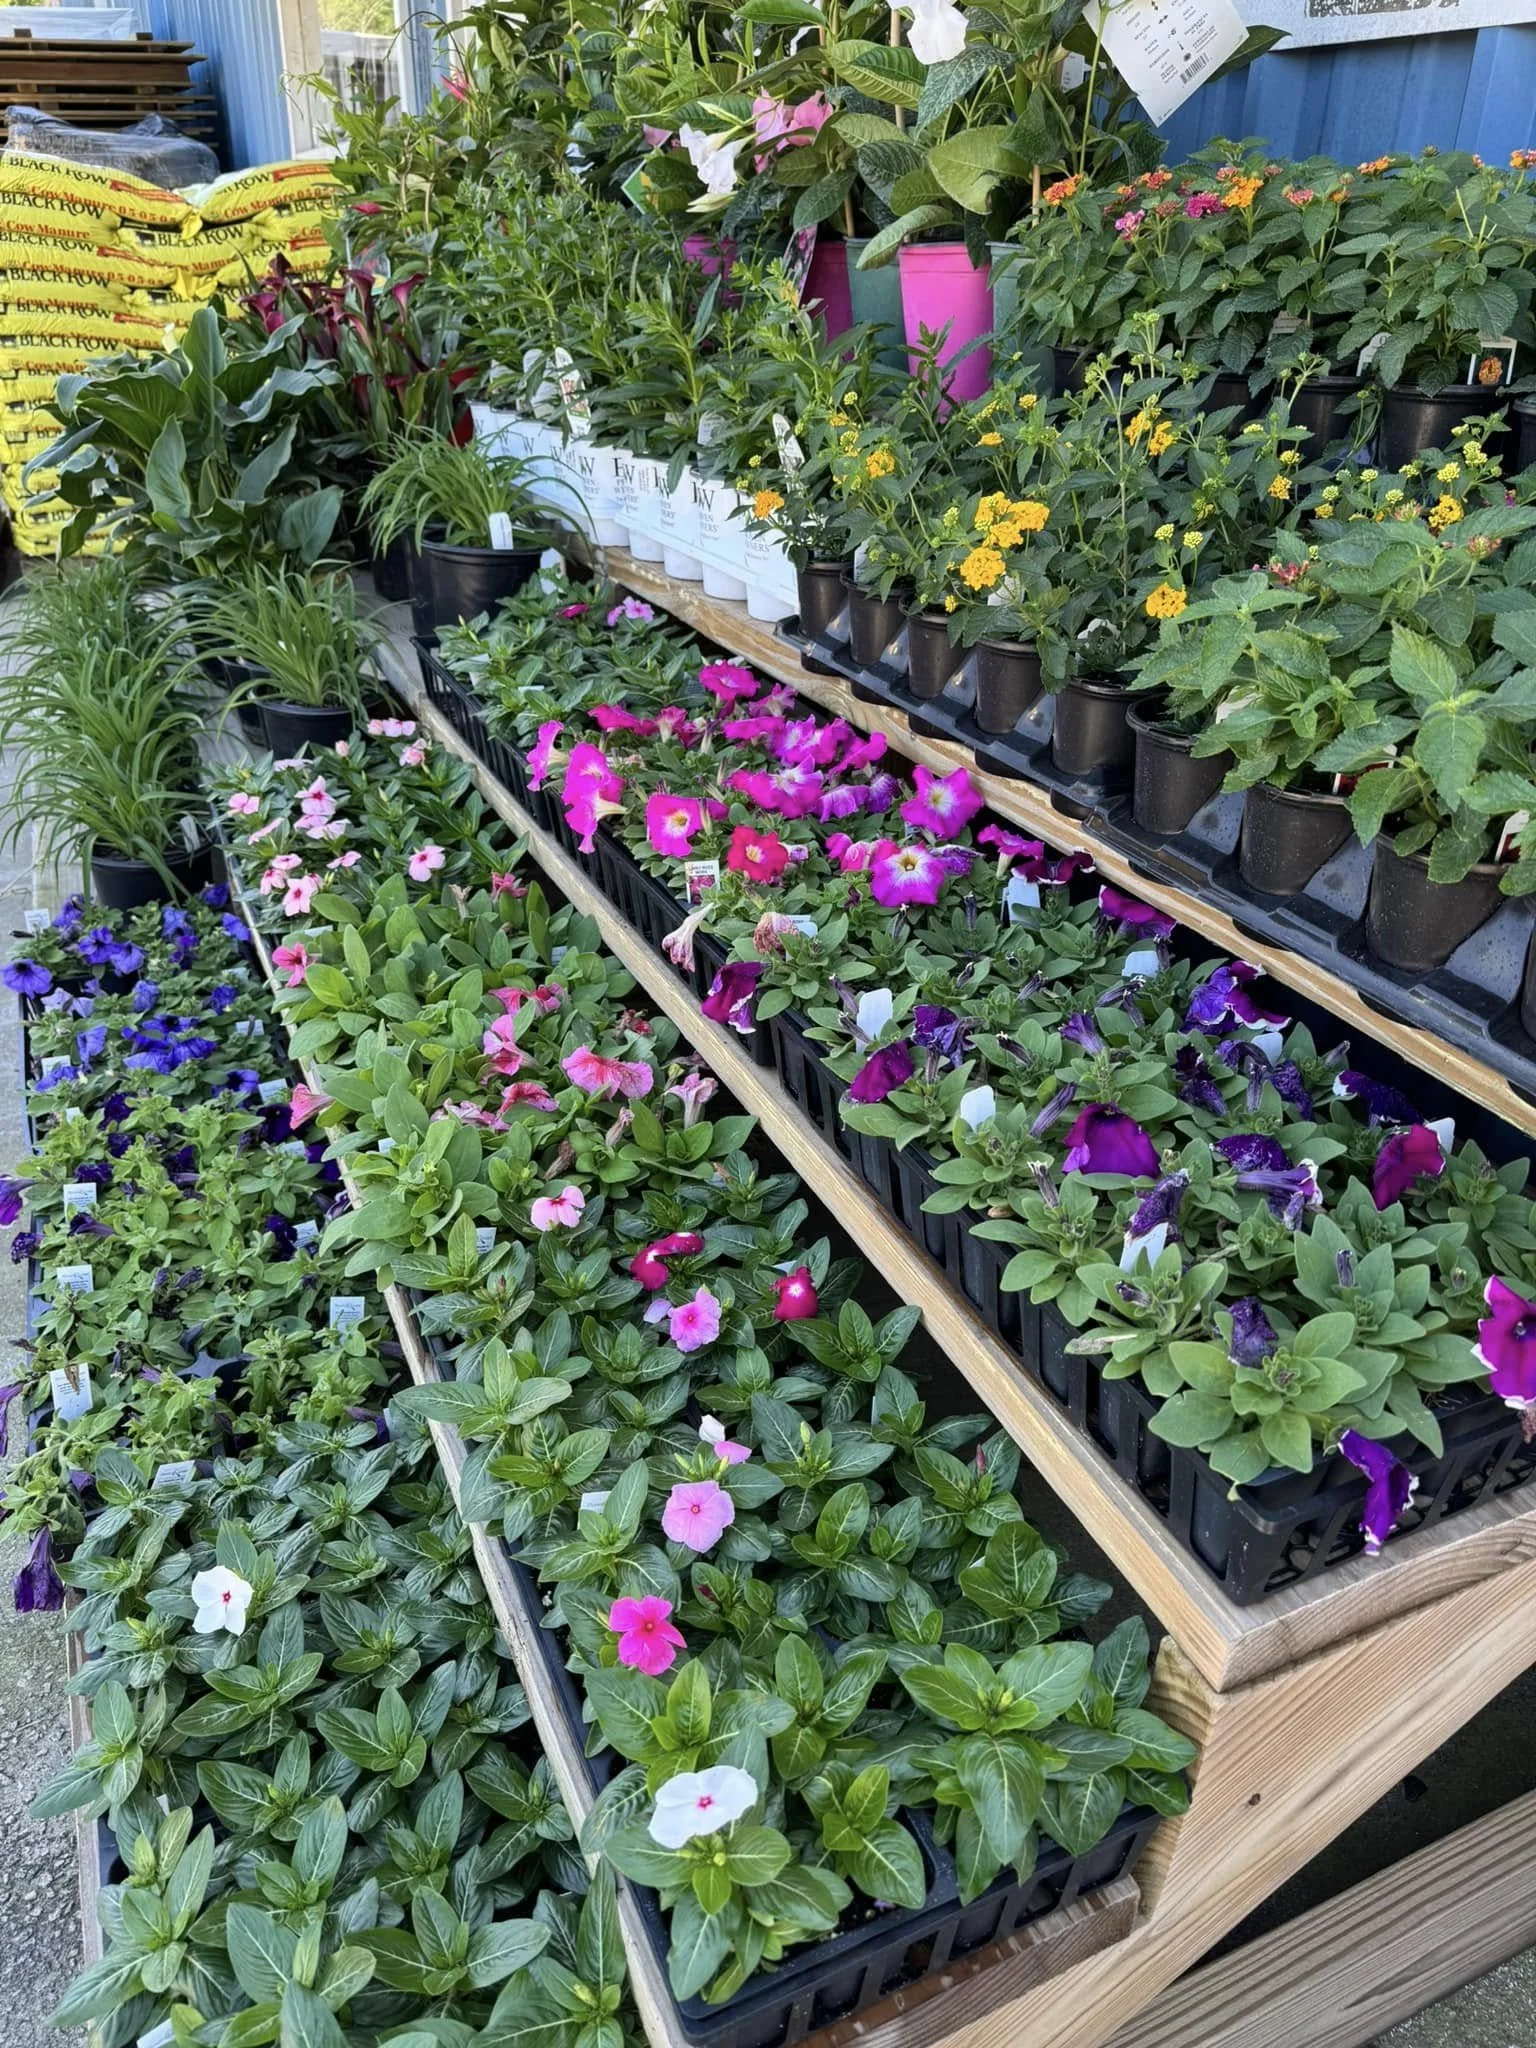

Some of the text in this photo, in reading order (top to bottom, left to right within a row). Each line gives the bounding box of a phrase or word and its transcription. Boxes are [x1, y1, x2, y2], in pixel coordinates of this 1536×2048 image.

[9, 156, 61, 174] BLACK
[1, 192, 104, 219] BLACK ROW
[224, 204, 249, 219] Cow
[6, 219, 91, 239] Cow Manure
[205, 225, 243, 246] ROW
[10, 268, 111, 289] BLACK ROW
[19, 334, 73, 348] BLACK
[76, 335, 119, 352] ROW
